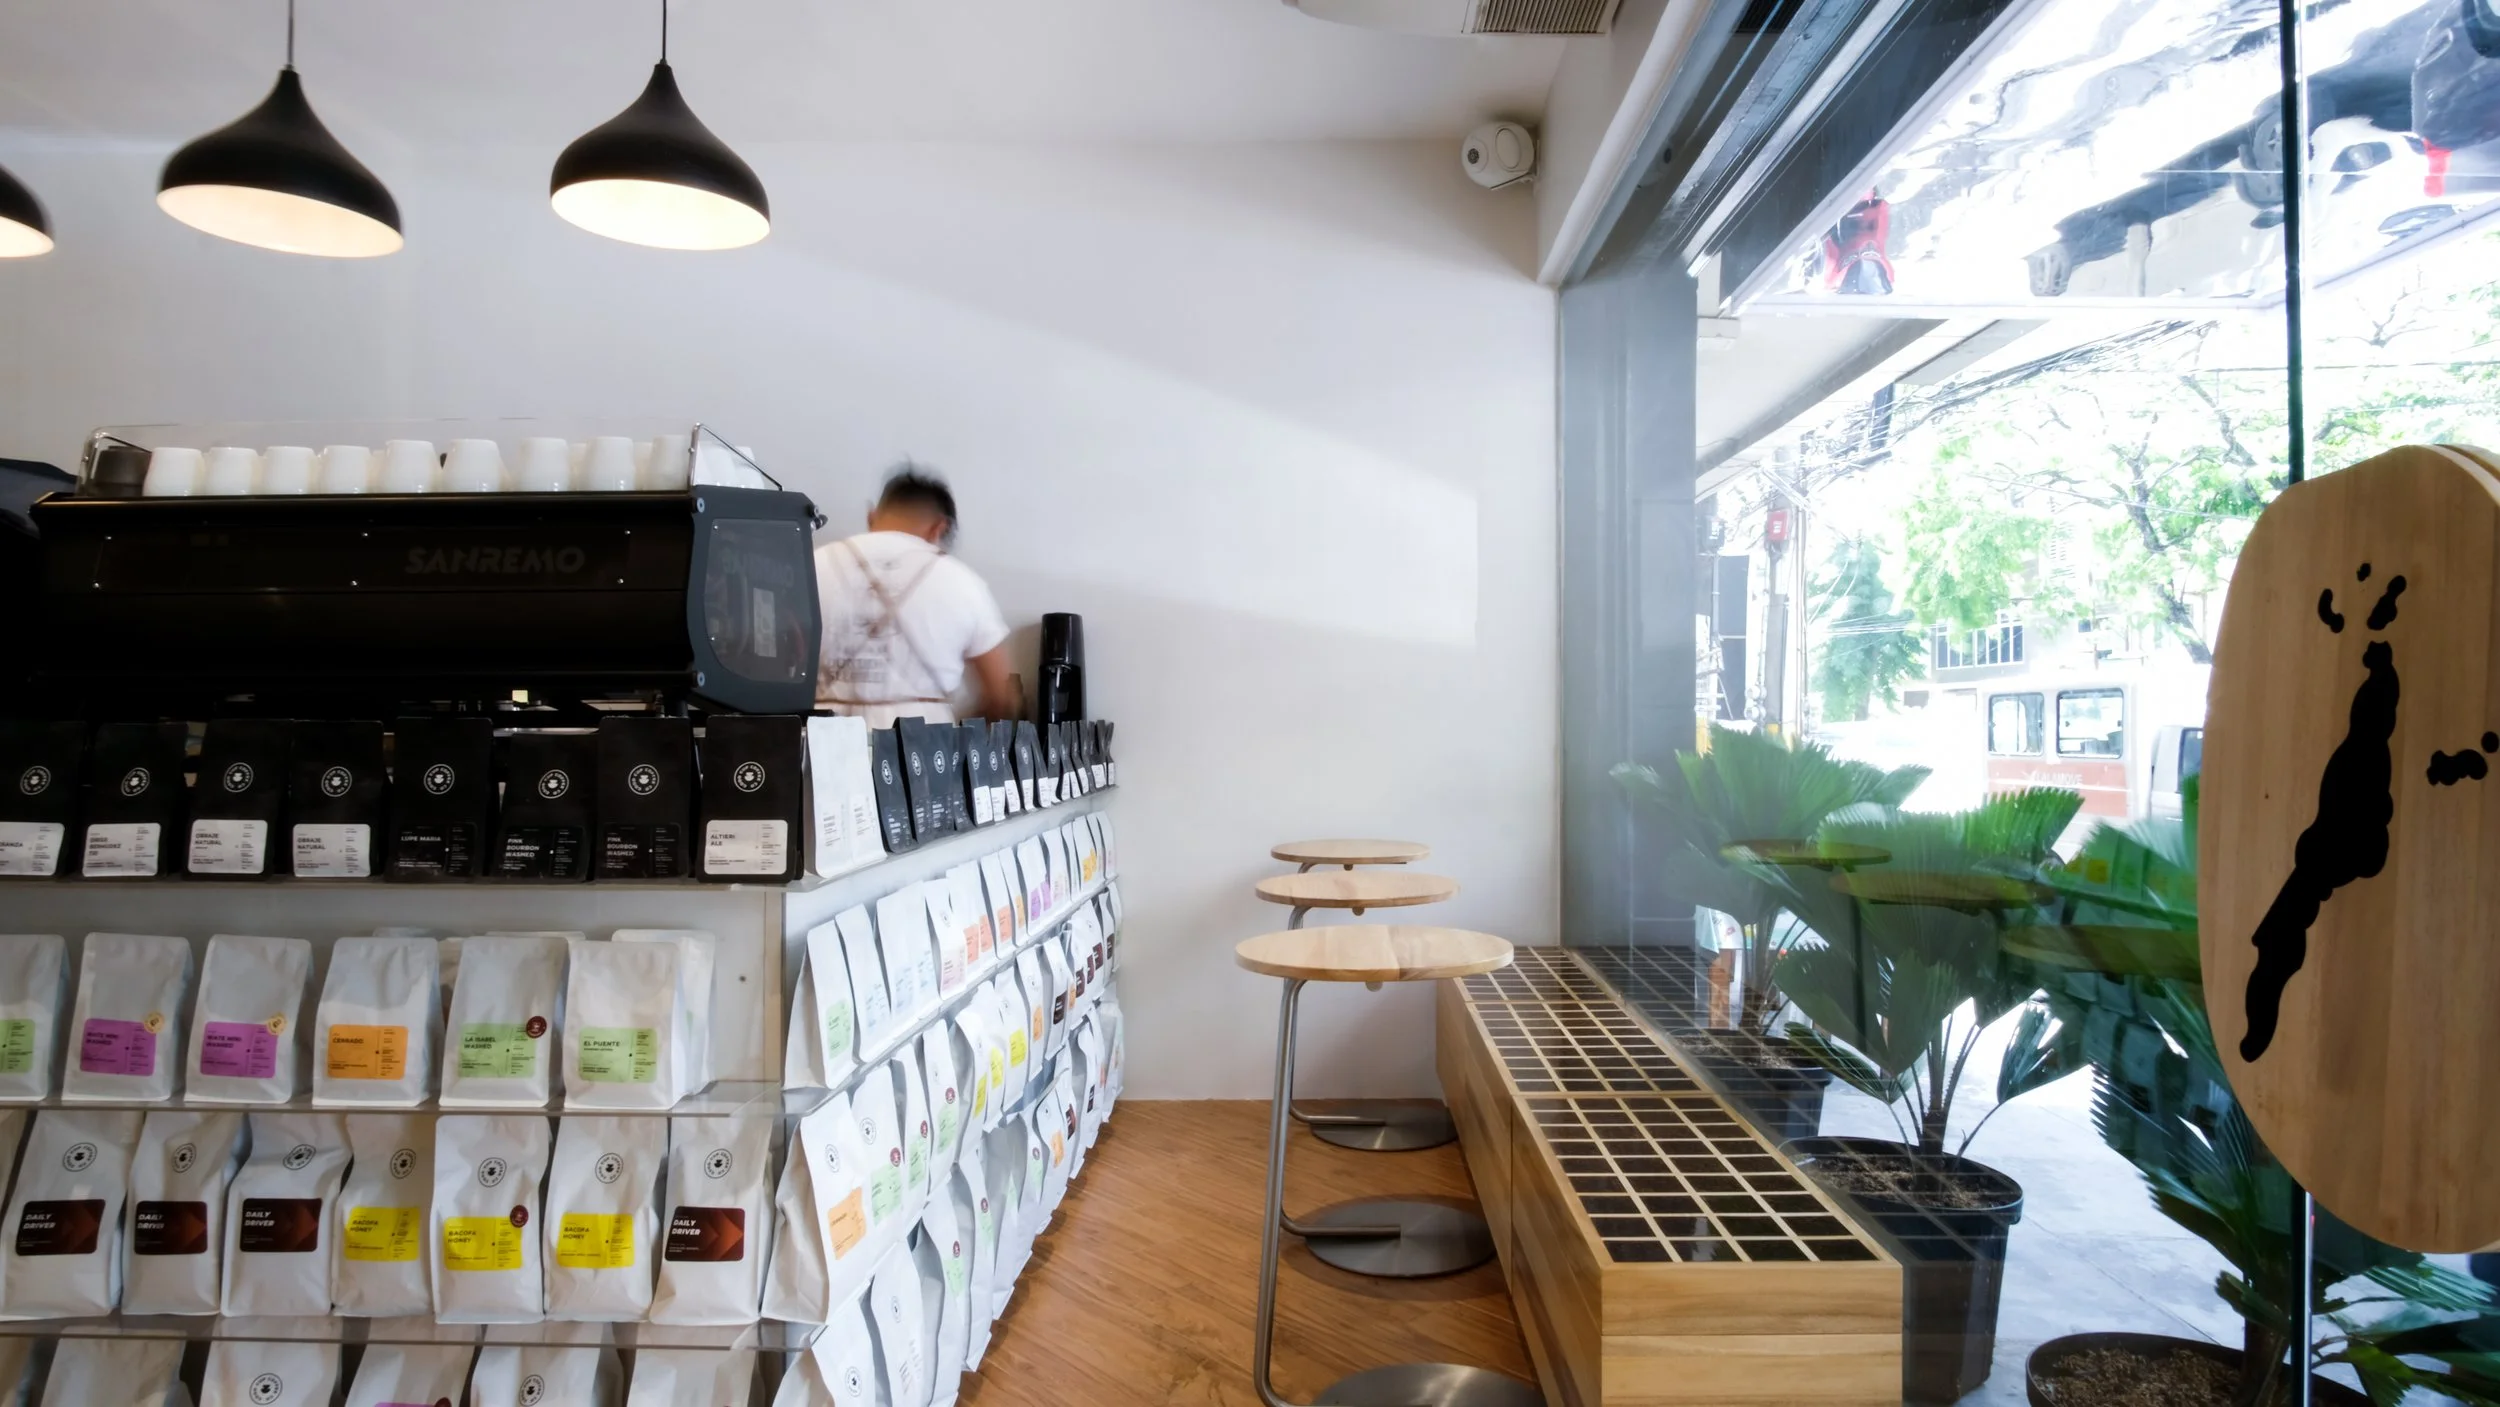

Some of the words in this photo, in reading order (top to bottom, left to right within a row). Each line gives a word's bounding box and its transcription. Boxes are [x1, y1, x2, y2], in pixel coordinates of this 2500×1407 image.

[404, 546, 586, 574] SANREMO
[25, 1213, 52, 1221] DAILY
[22, 1221, 56, 1230] DRIVER
[244, 1219, 275, 1227] DRIVER
[673, 1219, 697, 1227] DAILY
[671, 1228, 701, 1236] DRIVER
